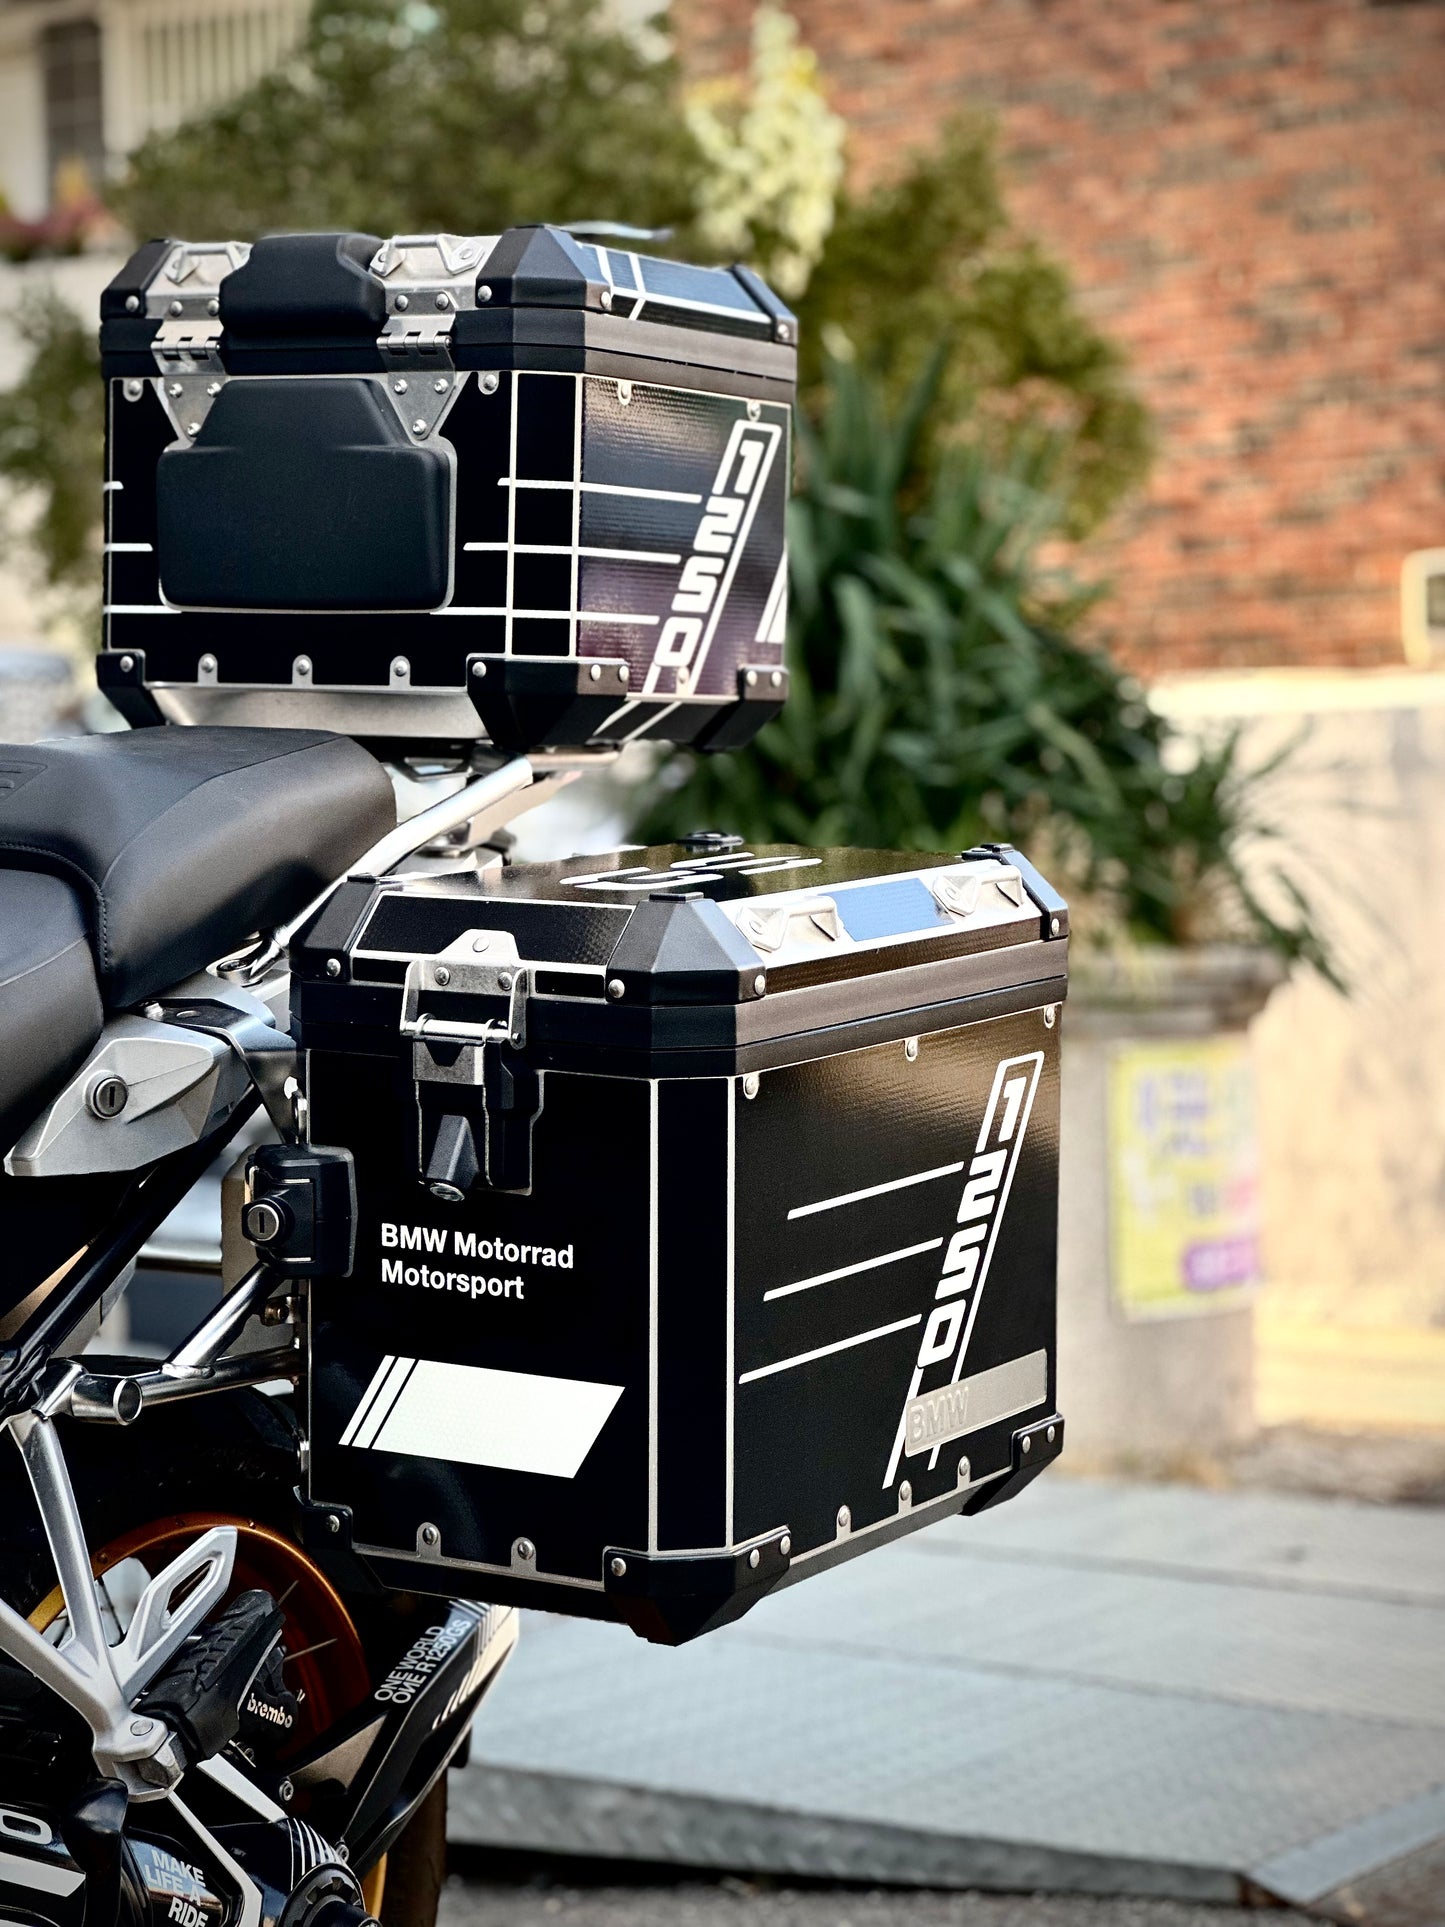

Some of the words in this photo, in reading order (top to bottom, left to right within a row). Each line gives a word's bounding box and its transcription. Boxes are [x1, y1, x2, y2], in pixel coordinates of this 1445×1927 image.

[653, 439, 764, 668] 1250
[917, 1076, 1028, 1368] 1250
[381, 1223, 448, 1253] BMW
[454, 1231, 574, 1269] Motorrad
[381, 1258, 525, 1299] Motorsport
[909, 1386, 969, 1444] BMW
[374, 1670, 410, 1701] ONE
[395, 1625, 445, 1670] WORLD
[246, 1692, 293, 1729] brembo
[144, 1864, 184, 1897] LIFE
[189, 1883, 201, 1907] A
[151, 1849, 206, 1887] MAKE
[167, 1896, 209, 1927] RIDE
